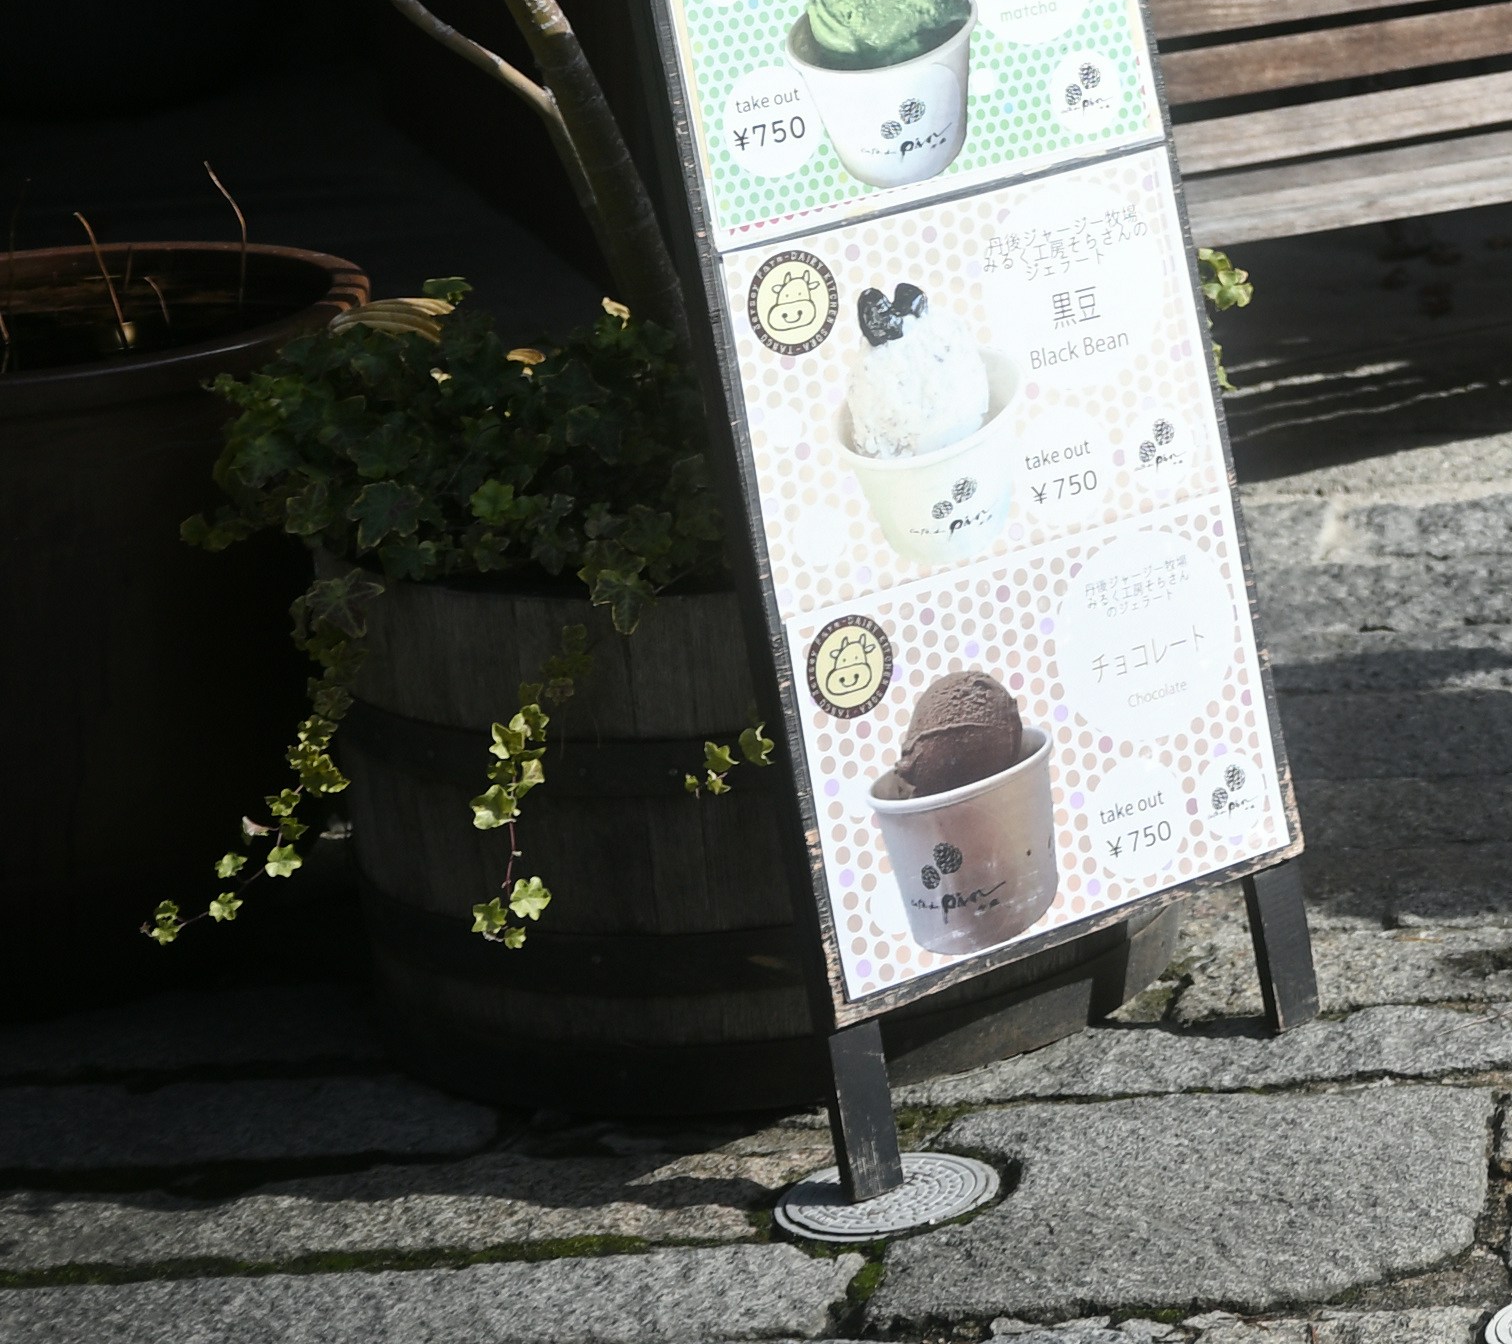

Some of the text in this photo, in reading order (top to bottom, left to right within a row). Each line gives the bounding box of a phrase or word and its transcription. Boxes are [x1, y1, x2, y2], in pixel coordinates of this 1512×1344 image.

[1000, 1, 1057, 22] matcha
[735, 88, 800, 114] take out
[732, 115, 806, 152] ¥750
[1052, 286, 1101, 330] 黒豆
[1030, 332, 1129, 370] Black Bean
[1025, 440, 1091, 471] take out
[1030, 470, 1098, 504] ¥750
[1091, 624, 1205, 683] チョコレート
[1127, 680, 1188, 708] Chocolate
[1100, 790, 1165, 825] take out
[1106, 820, 1172, 858] ¥750
